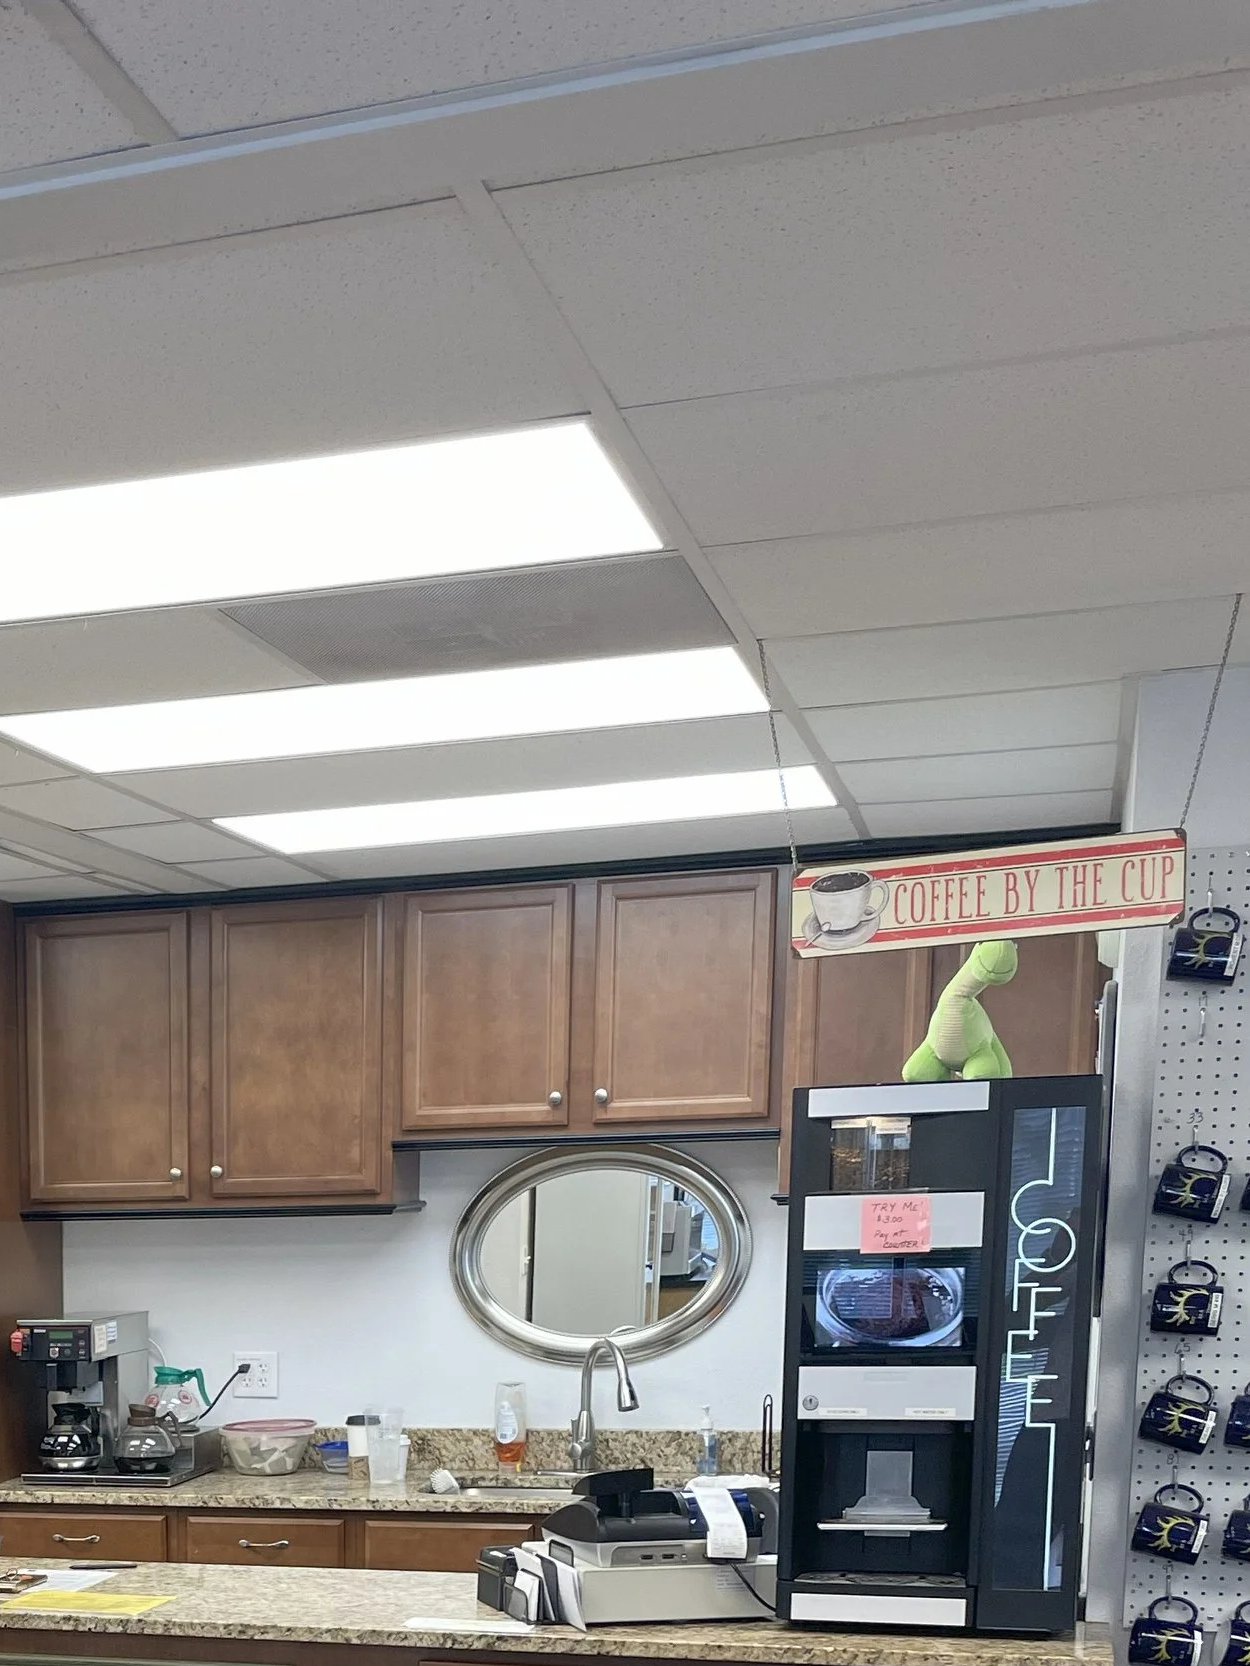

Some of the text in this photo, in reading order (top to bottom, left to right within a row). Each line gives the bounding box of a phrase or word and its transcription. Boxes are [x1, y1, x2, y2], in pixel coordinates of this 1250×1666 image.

[894, 855, 1175, 925] COFFEE BY THE CUP
[1187, 1112, 1204, 1124] 33
[870, 1202, 897, 1213] TRY
[877, 1214, 903, 1223] $3.00
[1006, 1180, 1076, 1427] COFFEE
